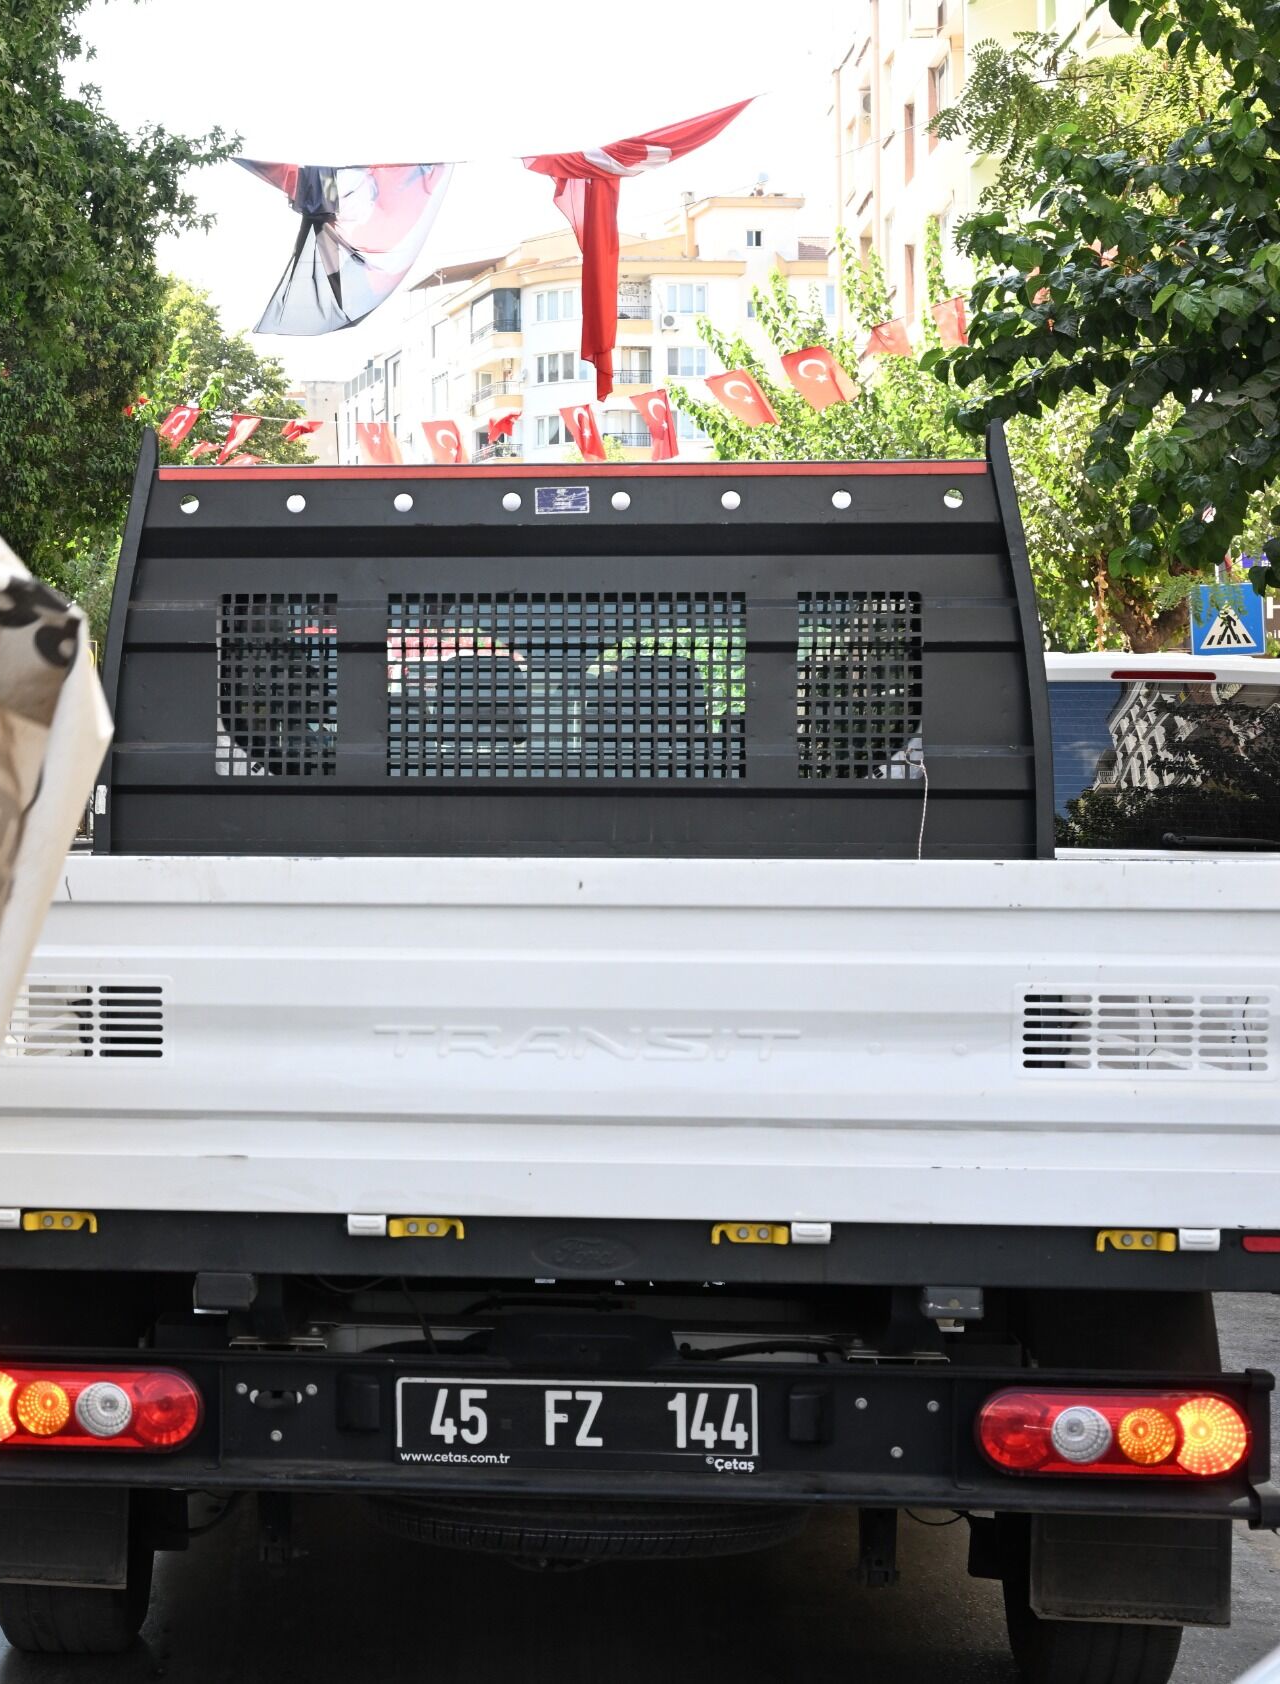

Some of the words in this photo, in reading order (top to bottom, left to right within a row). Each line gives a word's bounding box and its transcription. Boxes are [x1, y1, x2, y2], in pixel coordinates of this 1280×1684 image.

[373, 1024, 802, 1062] TRANSIT
[430, 1388, 488, 1445] 45
[545, 1390, 604, 1448] FZ
[667, 1392, 749, 1450] 144
[400, 1452, 511, 1464] www.cetas.com.tr
